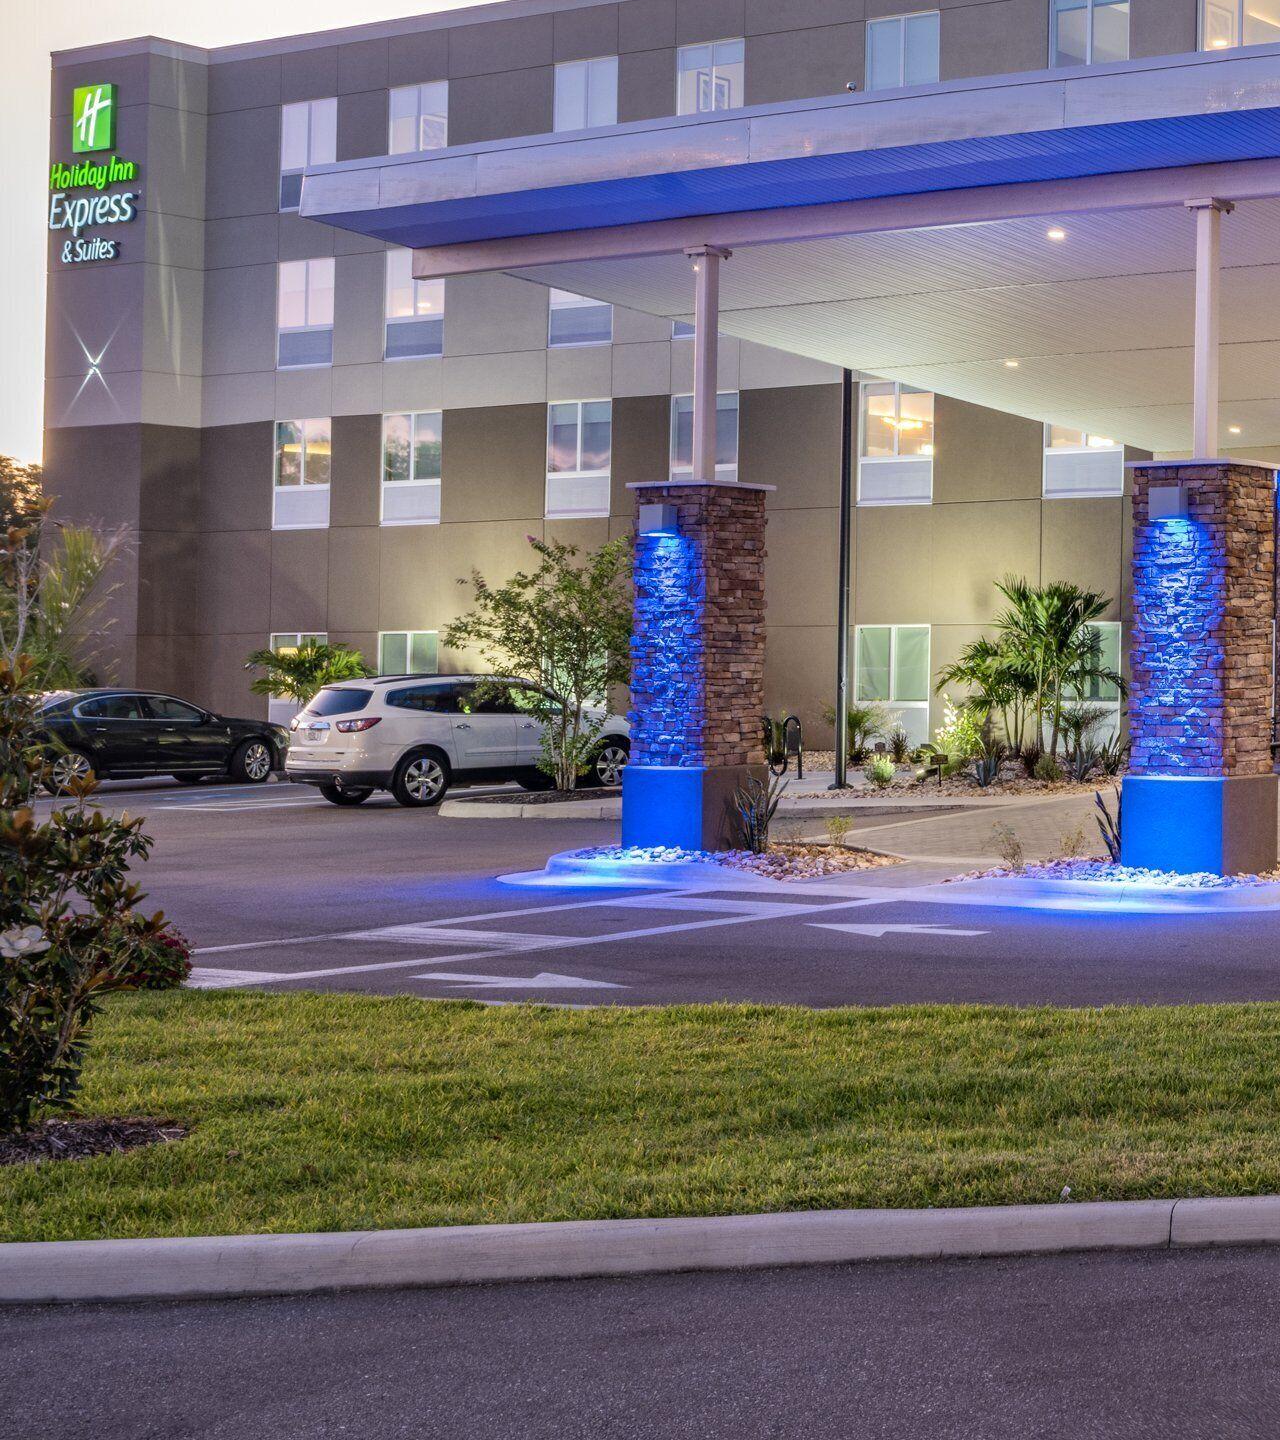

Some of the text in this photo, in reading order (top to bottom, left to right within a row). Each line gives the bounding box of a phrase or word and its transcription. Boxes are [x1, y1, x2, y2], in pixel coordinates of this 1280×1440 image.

[50, 156, 134, 189] Holiday Inn
[49, 192, 134, 236] Express
[61, 237, 115, 263] & Suites
